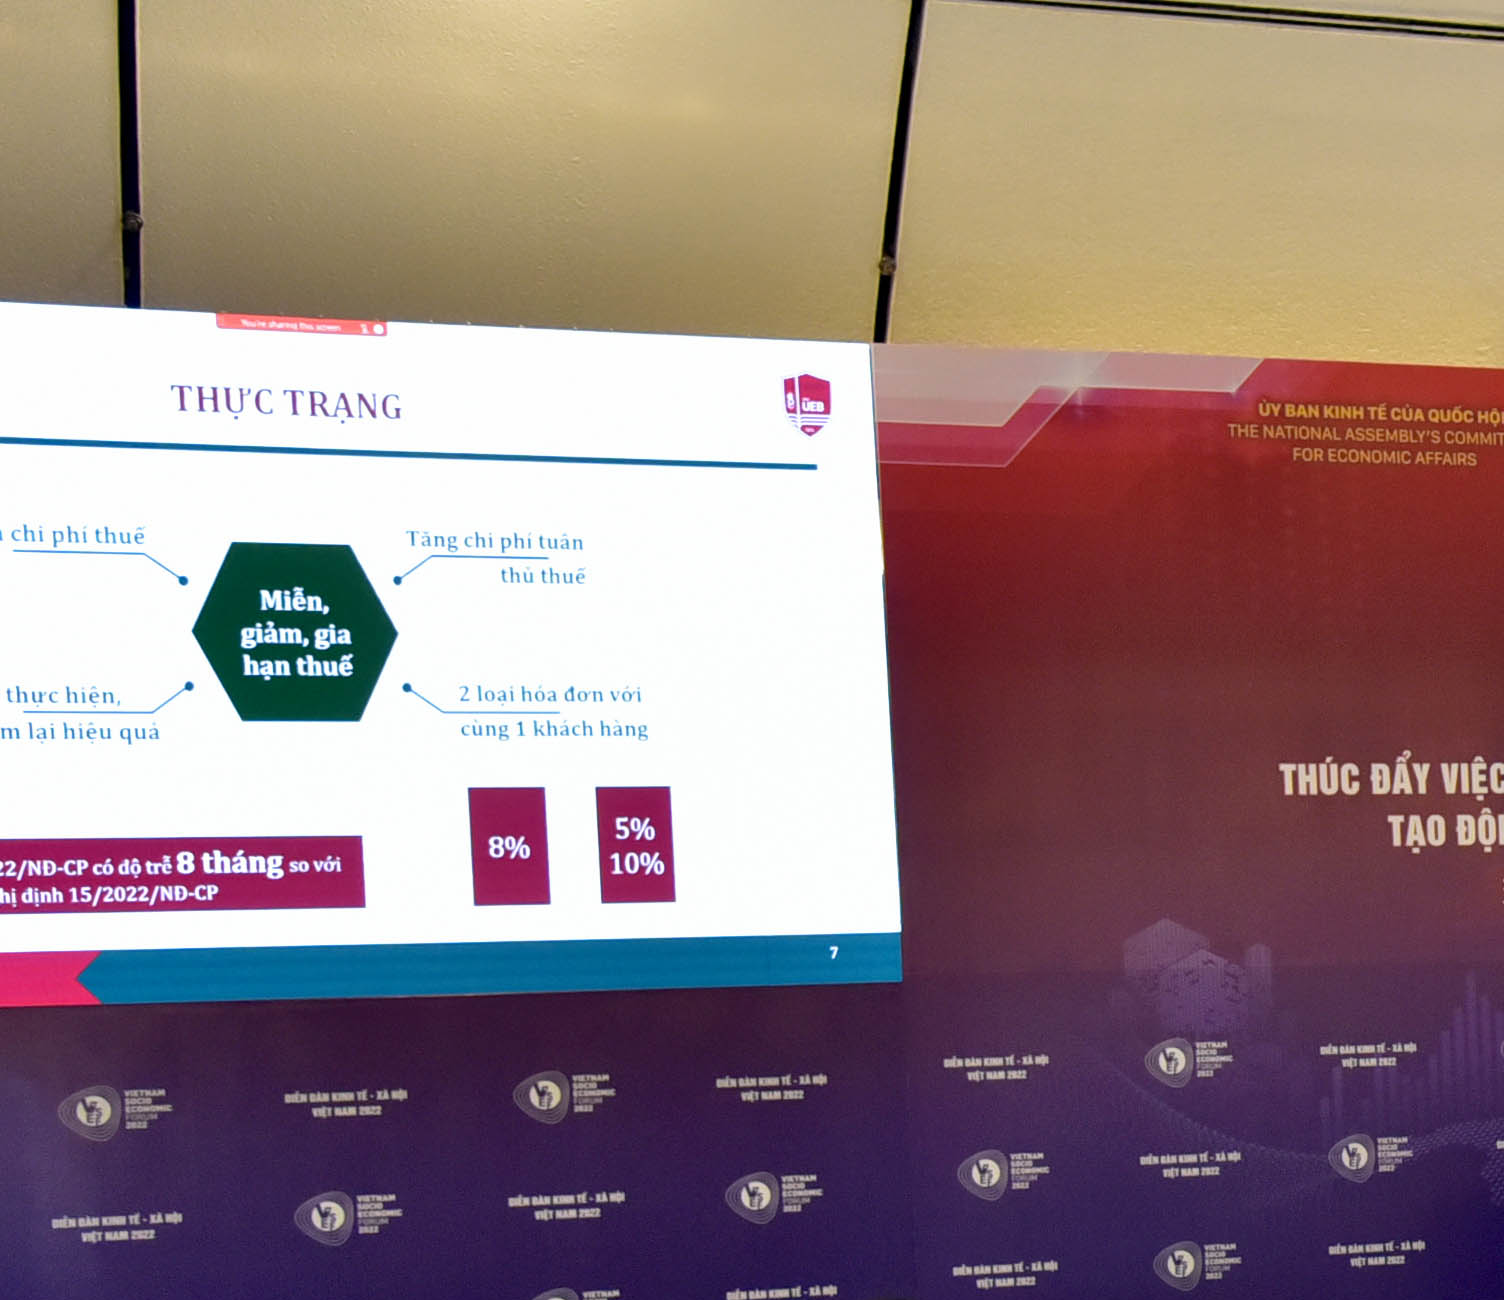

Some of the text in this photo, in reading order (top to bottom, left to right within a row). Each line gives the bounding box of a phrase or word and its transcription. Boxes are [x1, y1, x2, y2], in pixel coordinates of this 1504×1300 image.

[170, 385, 401, 424] THỰC TRẠNG
[1284, 403, 1320, 418] BAN
[1323, 405, 1364, 420] KINH
[1367, 403, 1388, 420] TẾ
[1390, 404, 1425, 422] CỦA
[1428, 406, 1474, 423] QUỐC
[1227, 423, 1259, 438] THE
[1263, 424, 1342, 441] NATIONAL
[1293, 447, 1478, 466] FOR ECONOMIC AFFAIRS
[11, 524, 145, 548] chi phí thuế
[406, 530, 583, 554] Tăng chi phí tuân
[501, 566, 585, 584] thủ thuế
[259, 586, 330, 615] Miễn,
[240, 621, 352, 650] giảm, gia
[242, 653, 354, 681] hạn thuế
[6, 685, 121, 706] thực hiện,
[459, 685, 642, 703] 2 loại hóa đơn với
[28, 722, 55, 744] lại
[63, 722, 112, 744] hiệu
[119, 727, 160, 745] quả
[461, 719, 649, 741] cùng 1 khách hàng
[1278, 756, 1360, 796] THÚC
[1370, 750, 1430, 795] ĐẨY
[615, 816, 656, 841] 5%
[488, 836, 531, 859] 8%
[610, 852, 665, 875] 10%
[21, 884, 219, 907] định 15/2022/NĐ-CP
[829, 946, 839, 959] 7
